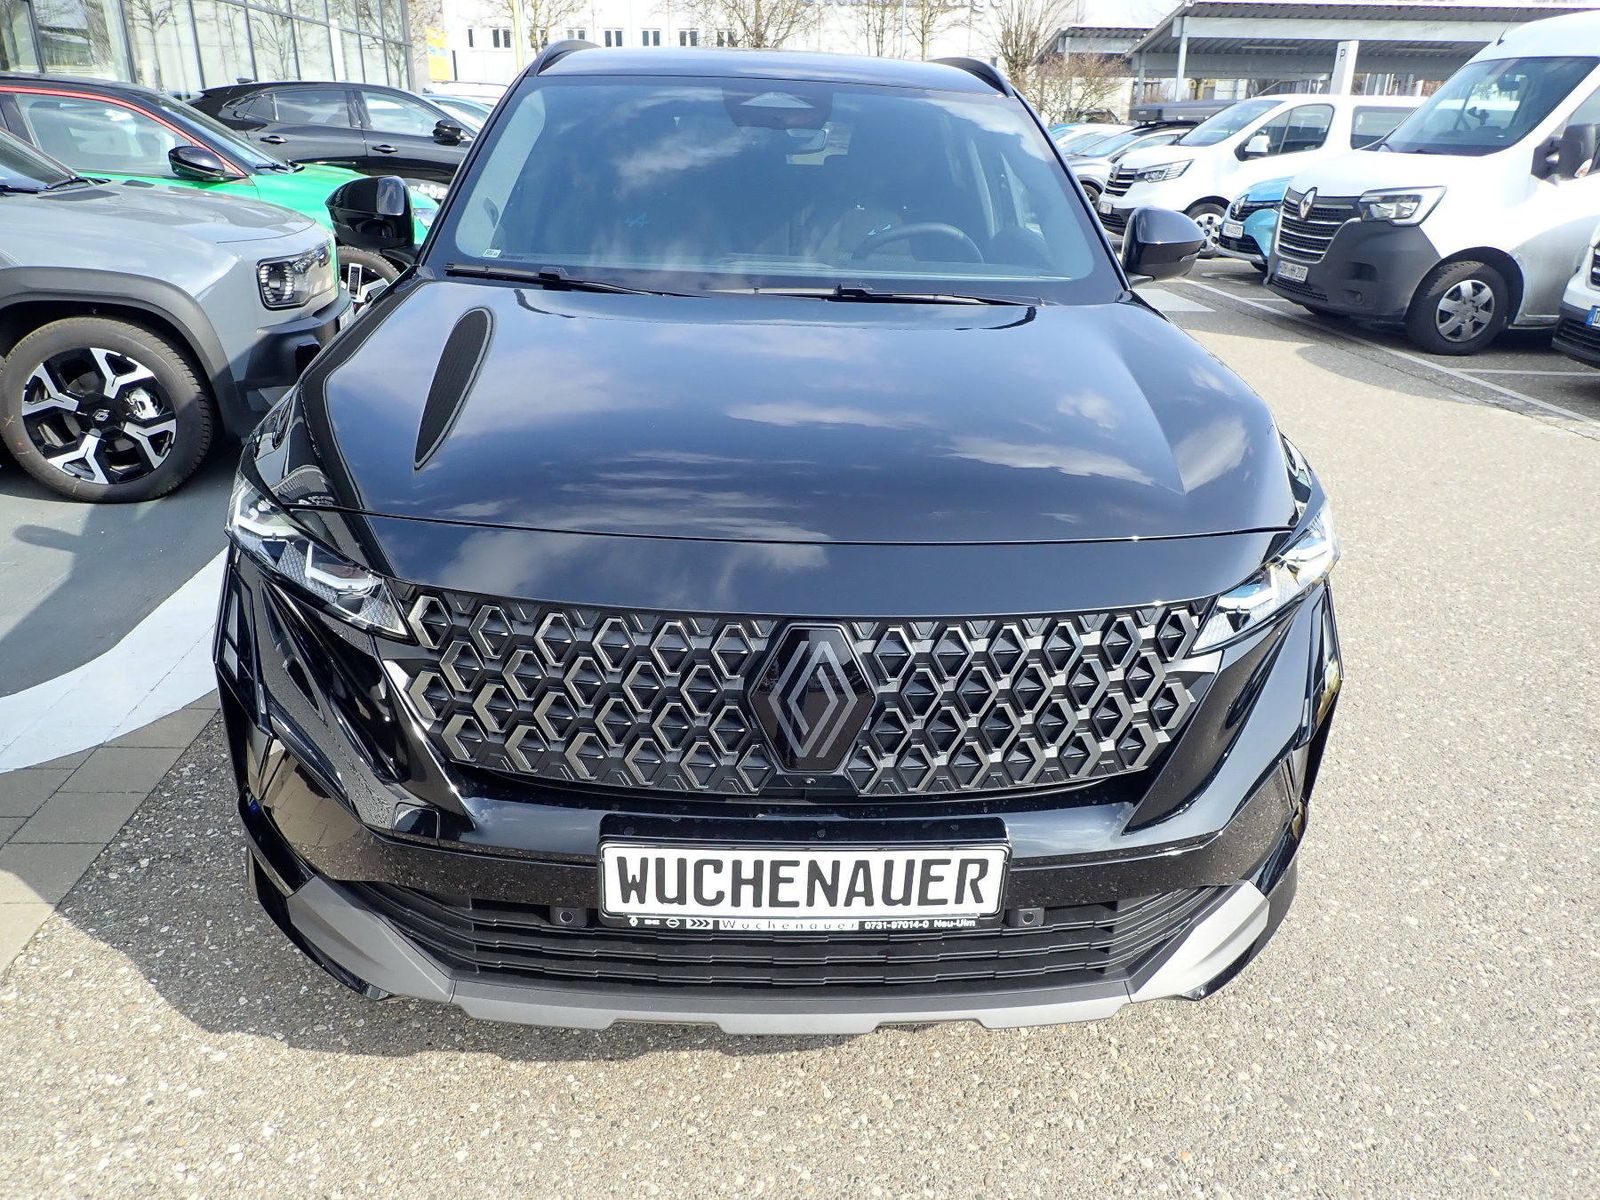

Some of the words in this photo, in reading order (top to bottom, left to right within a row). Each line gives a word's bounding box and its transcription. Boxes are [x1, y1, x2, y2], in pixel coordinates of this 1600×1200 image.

[616, 856, 989, 908] WUCHENAUER
[722, 919, 857, 930] Wuchenauer
[864, 920, 929, 930] 0731-97014-0
